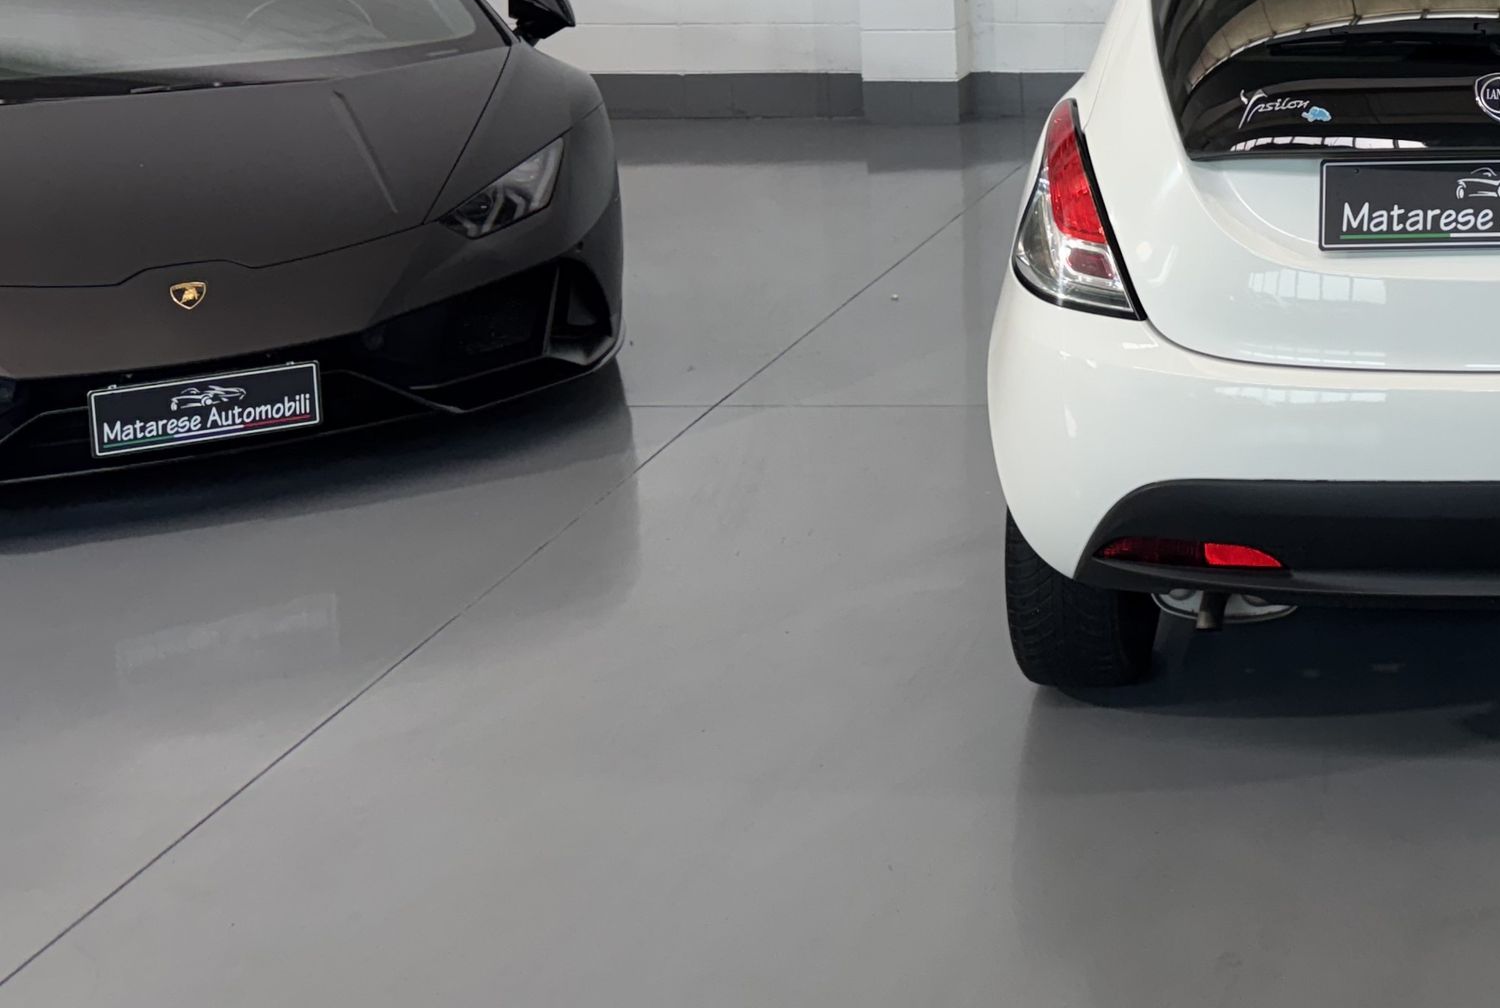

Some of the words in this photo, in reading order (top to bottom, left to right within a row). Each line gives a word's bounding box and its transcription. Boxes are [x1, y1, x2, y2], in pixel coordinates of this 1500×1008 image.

[1238, 89, 1310, 129] Ypsilon
[1342, 201, 1494, 233] Matarese
[103, 415, 201, 443] Matarese
[206, 393, 310, 428] Automobili
